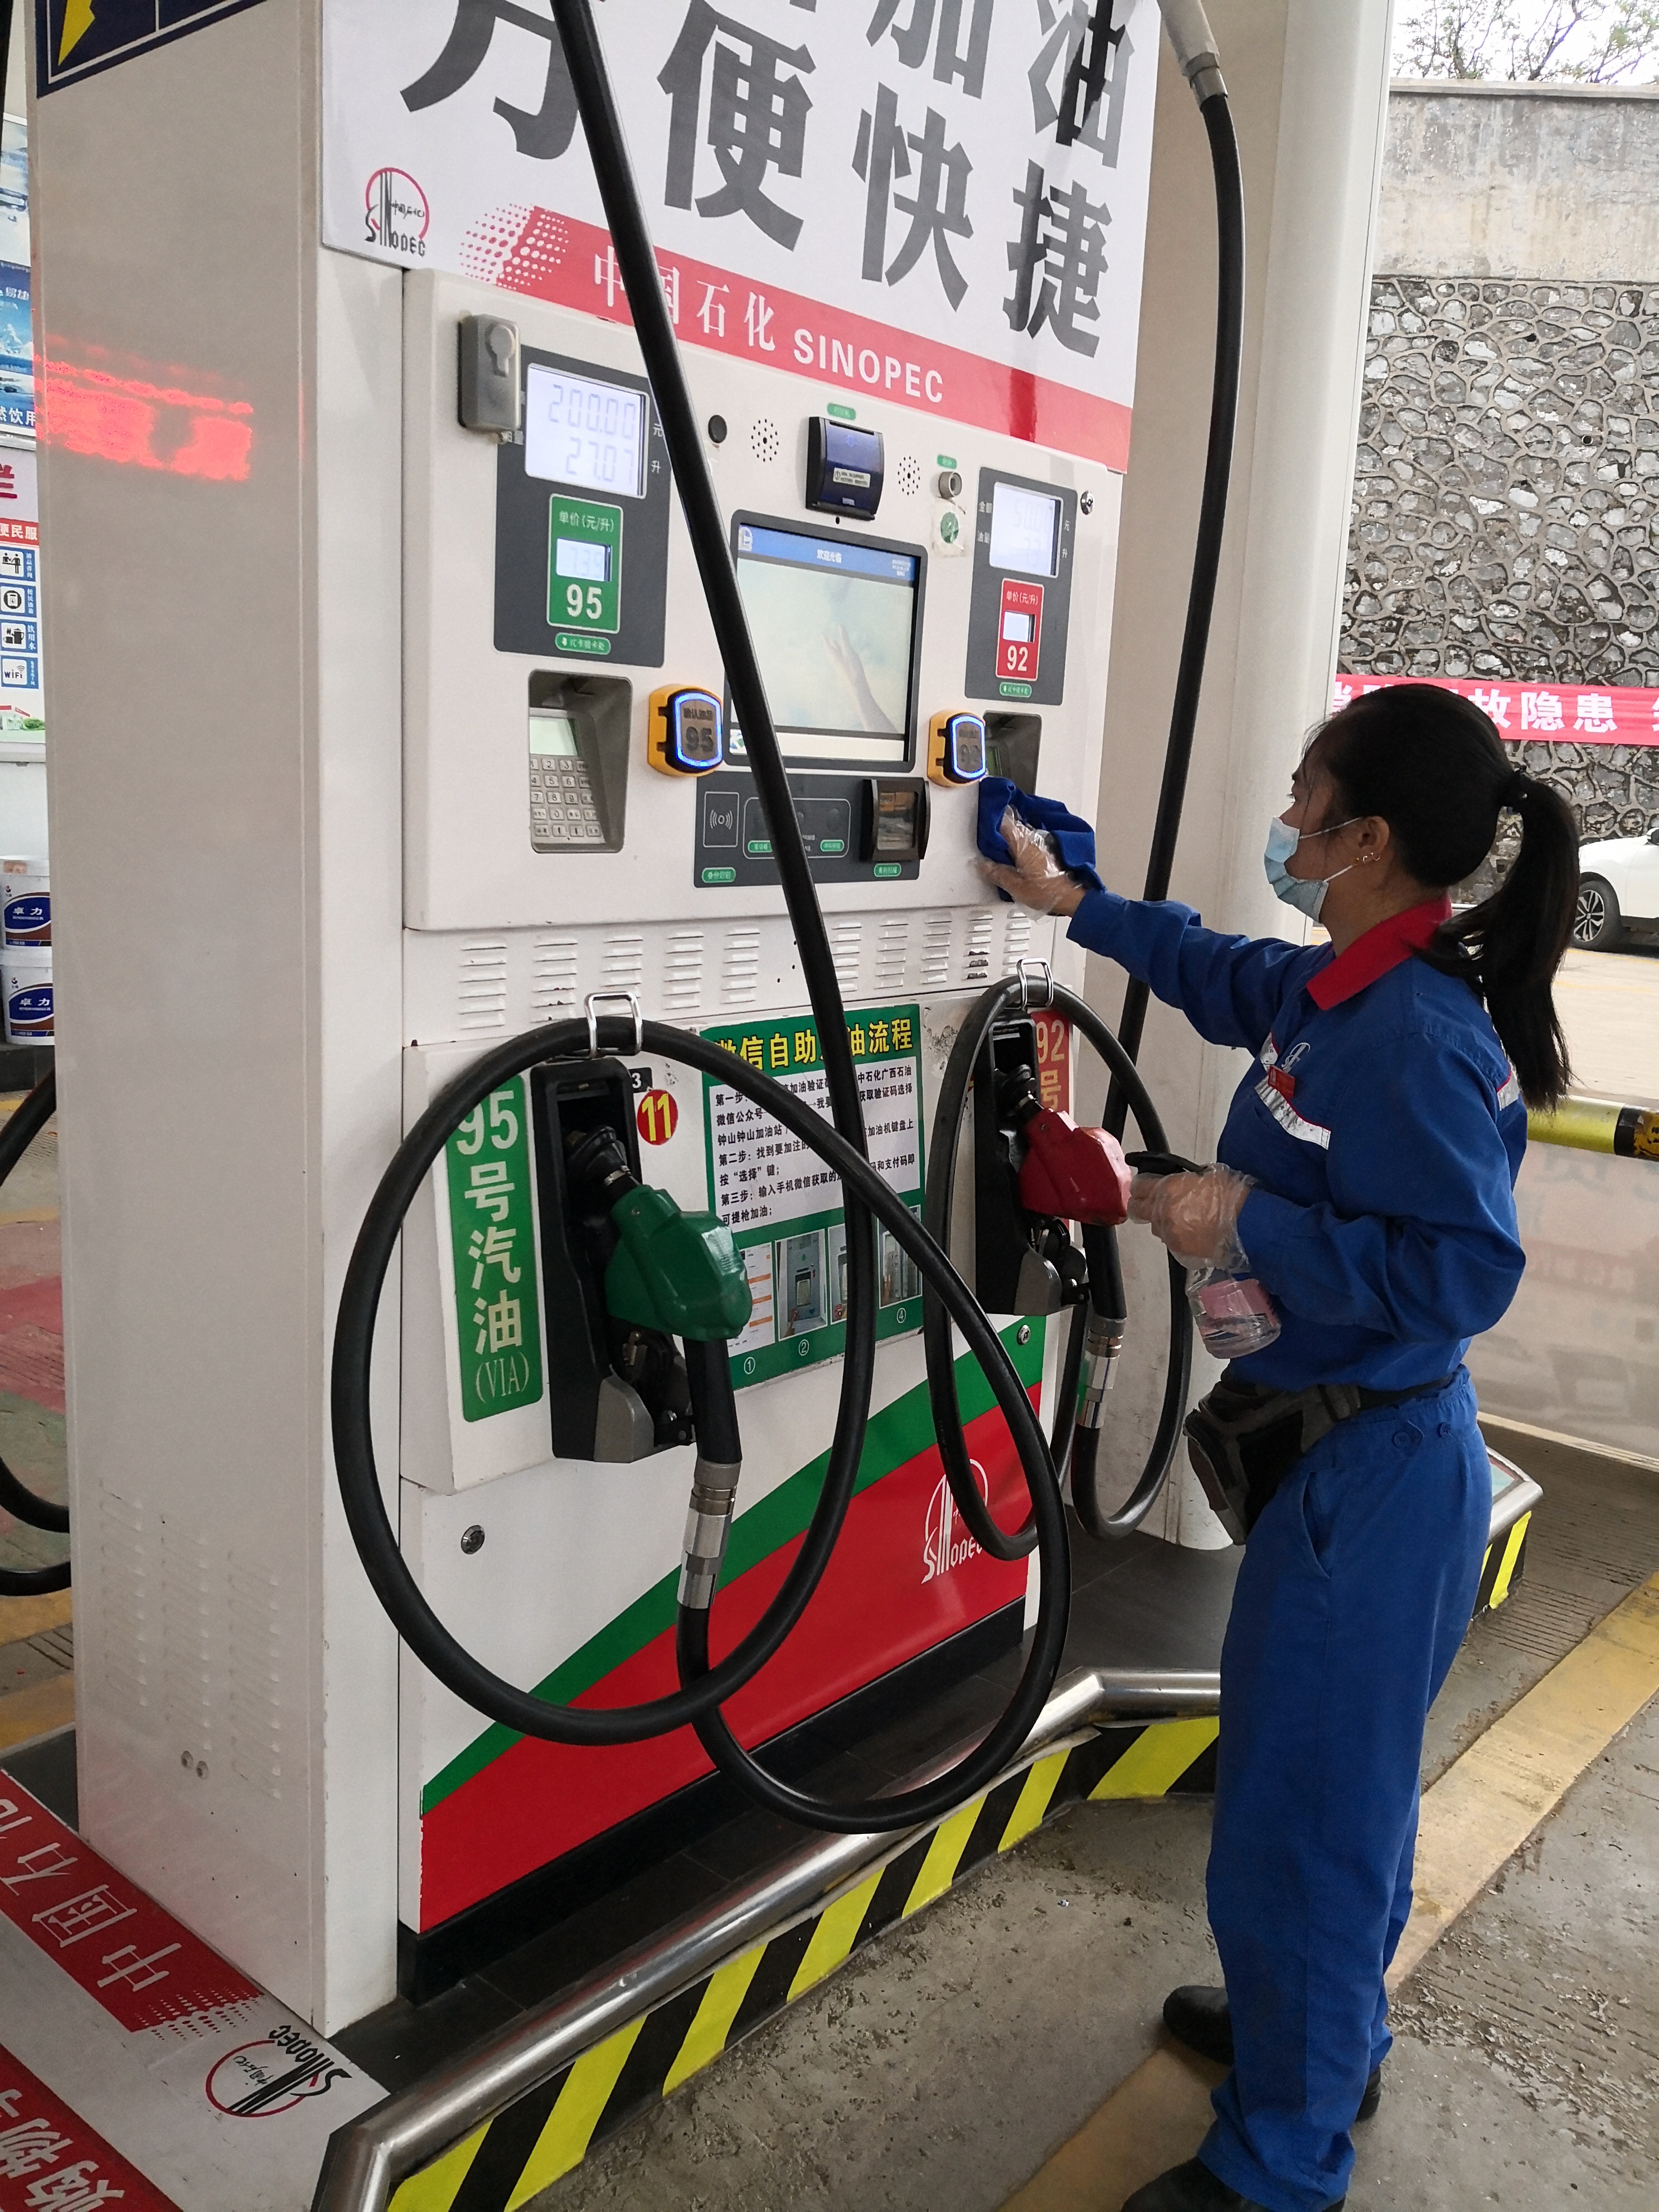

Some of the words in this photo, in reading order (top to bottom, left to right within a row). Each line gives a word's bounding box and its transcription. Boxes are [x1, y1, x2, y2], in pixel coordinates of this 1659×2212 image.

[793, 328, 944, 403] SINOPEC
[549, 384, 636, 439] 200.00
[566, 436, 634, 486] 27.07
[651, 460, 661, 473] 升
[566, 584, 603, 620] 95
[1007, 645, 1029, 672] 92
[686, 726, 714, 753] 95
[715, 1018, 913, 1070] 信自助油流程
[858, 1065, 912, 1083] 中石化广西石油
[642, 1093, 672, 1142] 11
[865, 1119, 914, 1137] 加油机键盘上
[476, 1352, 529, 1403] (VIA)
[0, 2089, 124, 2212] 购物
